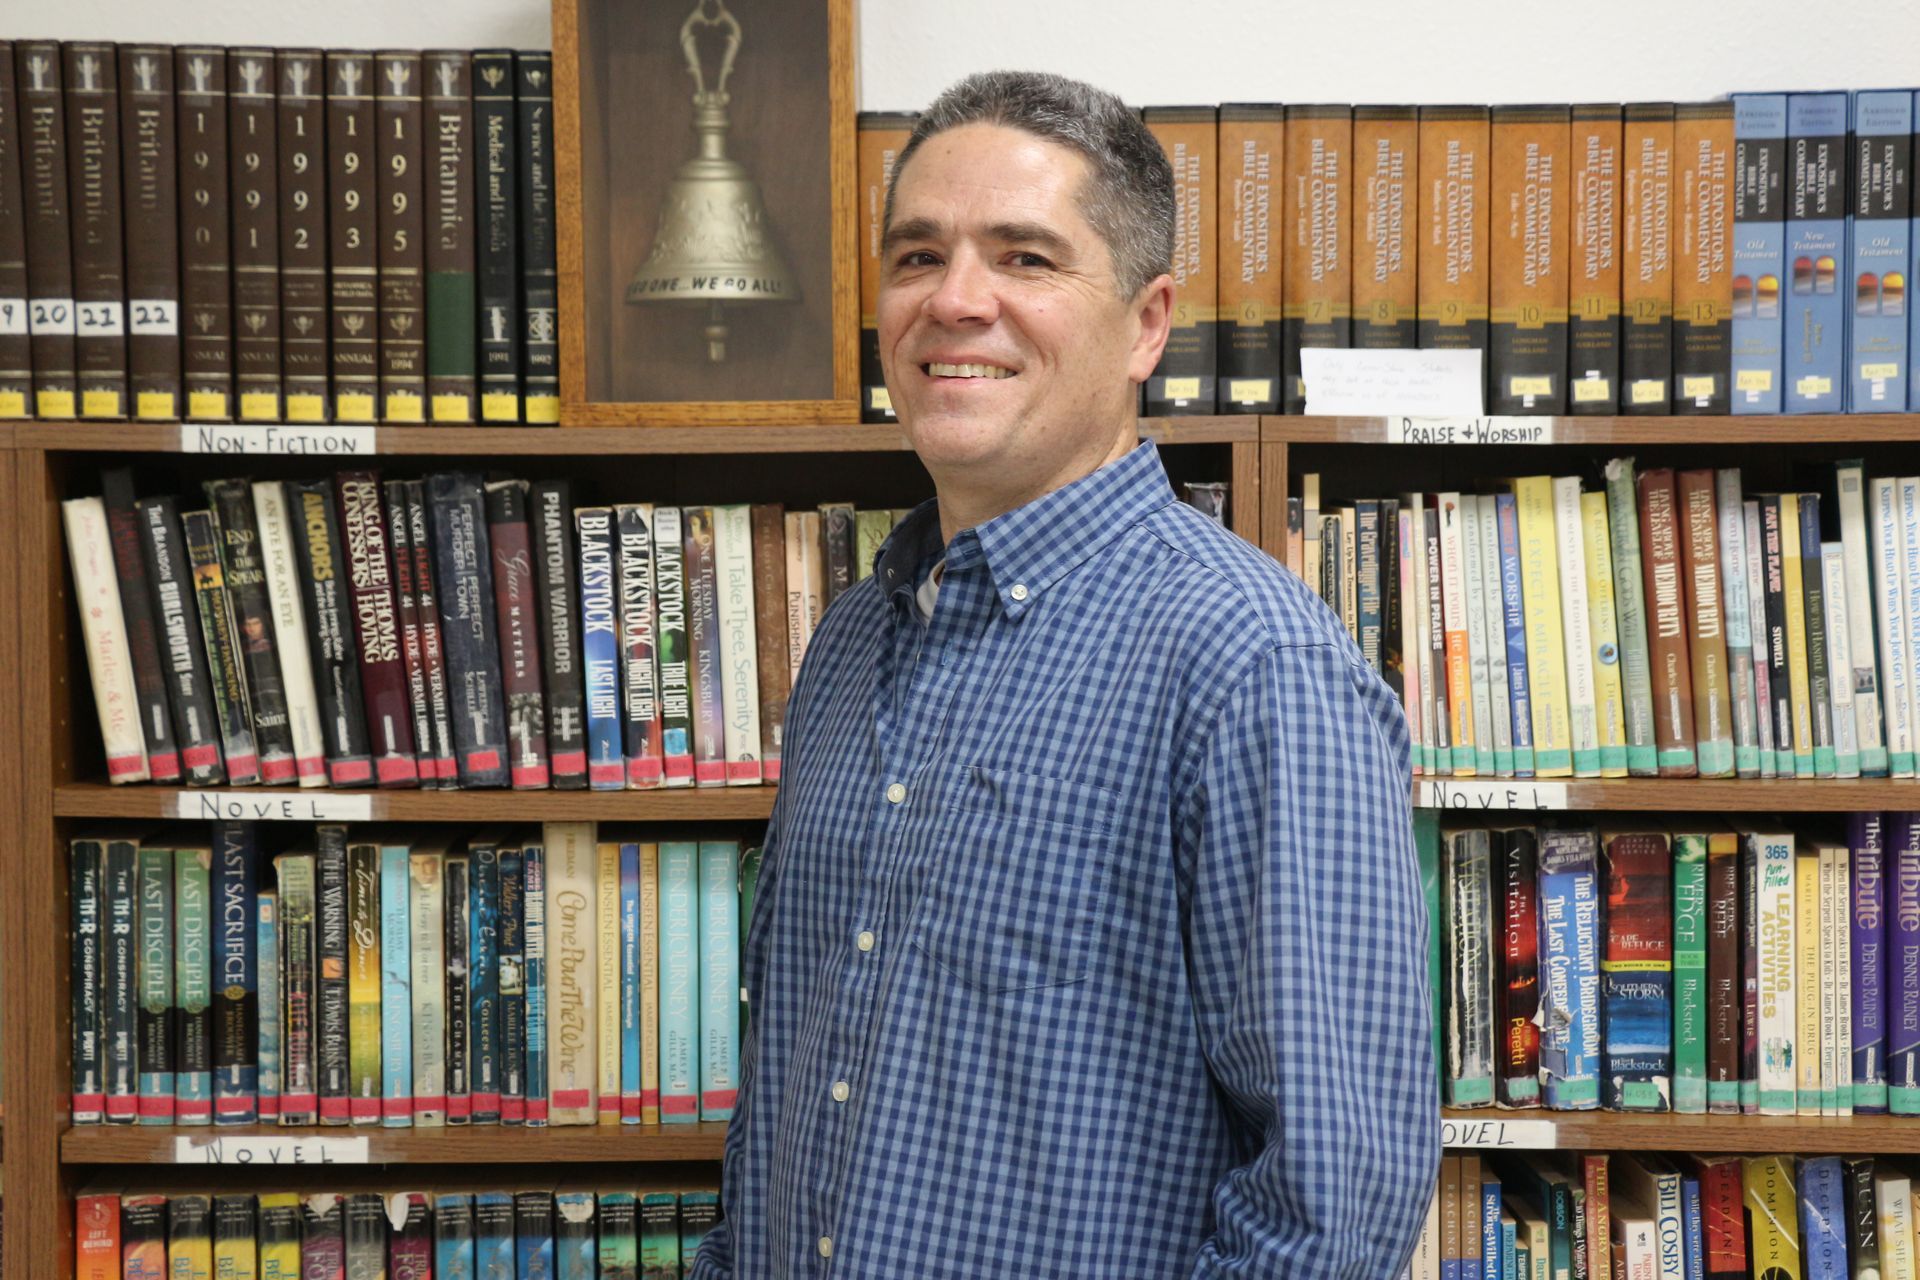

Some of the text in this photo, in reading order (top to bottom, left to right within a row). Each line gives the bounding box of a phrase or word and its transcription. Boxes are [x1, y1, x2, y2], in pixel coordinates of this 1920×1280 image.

[439, 114, 463, 250] Britannica
[1445, 140, 1459, 283] BIBLE COMMENTARY
[1460, 151, 1473, 272] THE EXPOSITOR'S
[1585, 136, 1599, 280] BIBLE COMMENTARY
[1600, 147, 1613, 269] THE EXPOSITOR'S
[1696, 139, 1710, 284] BIBLE COMMENTARY
[1711, 151, 1725, 273] THE EXPOSITOR'S
[1735, 143, 1746, 218] COMMENTARY
[1795, 139, 1806, 218] COMMENTARY
[1734, 249, 1779, 260] Testament
[1792, 240, 1835, 251] Testament
[35, 305, 67, 324] 20
[83, 308, 115, 327] 21
[135, 306, 169, 325] 22
[692, 277, 719, 289] WE
[1312, 302, 1323, 318] 7
[1378, 303, 1388, 319] 8
[1446, 303, 1457, 318] 9
[1523, 306, 1539, 323] 10
[1585, 298, 1600, 315] 11
[1638, 302, 1656, 319] 12
[1695, 303, 1714, 321] 13
[1402, 417, 1455, 443] PRAISE
[1476, 417, 1543, 443] WORSHIP
[150, 526, 173, 580] BRANDON
[226, 530, 255, 545] END
[303, 493, 335, 582] ANCHORS
[341, 481, 372, 588] CONFESSORS
[358, 480, 389, 585] KING OF THE
[391, 504, 406, 548] ANGEL
[448, 508, 464, 570] MURDER
[461, 503, 475, 568] PERFECT
[265, 498, 294, 628] AN EYE FOR AN EYE
[457, 577, 469, 619] TOWN
[542, 492, 572, 674] PHANTOM WARRIOR
[699, 534, 714, 621] ONE TUESDAY
[728, 564, 746, 605] Take
[1357, 511, 1379, 614] The Gravedigger File
[1428, 537, 1443, 650] POWER IN PRAISE
[1503, 556, 1520, 628] WORSHIP
[158, 582, 194, 673] BURLSWORTH
[356, 594, 382, 664] HOVING
[373, 590, 399, 662] THOMAS
[401, 595, 414, 607] 44
[468, 576, 485, 642] PERFECT
[579, 515, 616, 719] BLACKSTOCK LAST LIGHT
[621, 533, 655, 721] BLACKSTOCK NIGHT LIGHT
[656, 542, 688, 718] LACKSTOCK TRUE LIGHT
[690, 577, 704, 641] MORNING
[730, 607, 749, 658] Thee,
[1653, 562, 1681, 638] MEDIOCRITY
[405, 623, 419, 660] HYDE
[510, 606, 524, 678] MATTERS
[1771, 626, 1784, 667] STOWELL
[106, 692, 122, 704] &
[697, 648, 713, 726] KINGSBURY
[731, 658, 754, 733] Serenity
[201, 793, 325, 820] NOVEL
[1433, 781, 1548, 809] NOVEL
[1765, 845, 1789, 859] 365
[1856, 817, 1883, 930] The Tribute
[145, 866, 165, 1000] LAST DISCIPLE
[224, 830, 246, 984] LAST SACRIFICE
[324, 886, 343, 948] WARNING
[643, 855, 655, 993] THE UNSEEN ESSENTIAL
[708, 852, 731, 1018] TENDER JOURNEY
[1547, 895, 1568, 953] THE LAST
[1676, 884, 1695, 943] EDGE
[1776, 892, 1791, 994] LEARNING
[116, 937, 128, 1013] CONSPIRACY
[556, 890, 587, 1075] Come Pour The Wine
[1573, 874, 1601, 1058] THE RELUCTANT BRIDEGROOM
[1761, 910, 1777, 1019] ACTIVITIES
[1862, 942, 1878, 1030] DENNIS RAINEY
[326, 1000, 342, 1068] DAVIS BUNN
[1510, 1017, 1526, 1066] Peretti
[1683, 978, 1698, 1045] Blackstock
[207, 1137, 333, 1163] NOVEL
[1442, 1123, 1514, 1145] OVEL
[1483, 1194, 1499, 1274] Strong-Willed
[1554, 1190, 1567, 1230] DOBSON
[1596, 1166, 1609, 1256] THE ANGRY
[1656, 1175, 1680, 1277] BILL COSBY
[1719, 1168, 1733, 1261] DEADLINE
[1765, 1166, 1779, 1261] DOMINION
[1818, 1169, 1832, 1272] DECEPTION
[1856, 1172, 1874, 1249] BUNN
